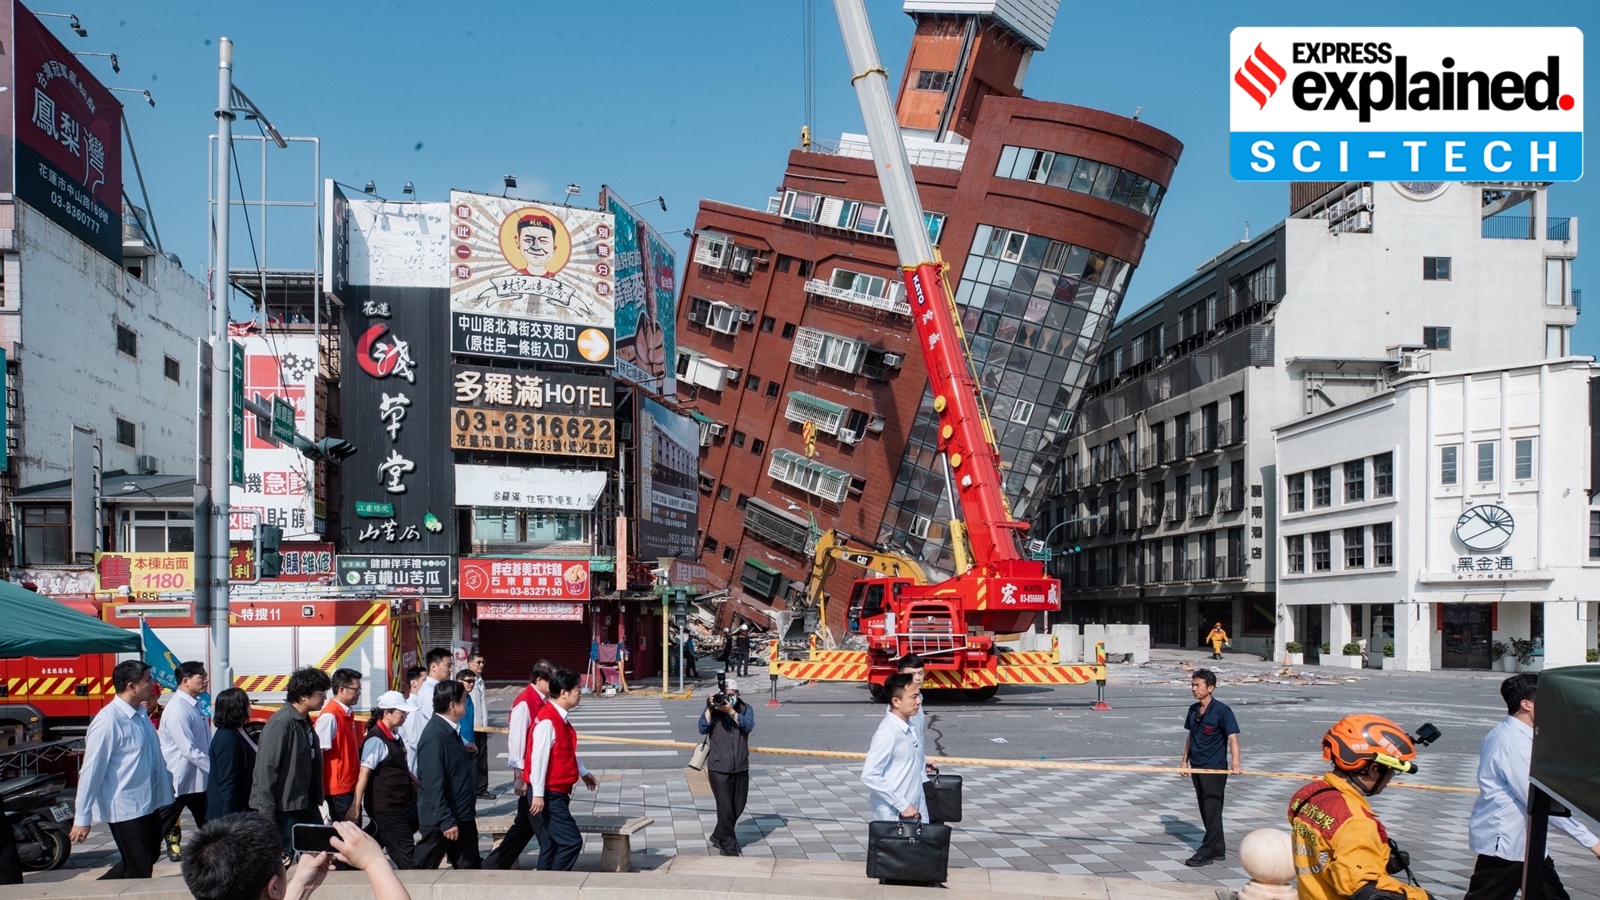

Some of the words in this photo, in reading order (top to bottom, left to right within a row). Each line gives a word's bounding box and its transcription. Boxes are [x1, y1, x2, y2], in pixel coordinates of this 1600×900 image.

[51, 191, 100, 234] 03-8360777
[913, 274, 925, 304] KATO
[458, 314, 576, 341] 中山路北濱街交叉路口
[465, 335, 569, 360] (原住民一條街入口)
[545, 383, 612, 407] HOTEL
[455, 409, 613, 440] 03-8316622
[134, 557, 189, 570] 本棟店面
[856, 555, 869, 565] CAT
[1457, 556, 1513, 572] 黑金通
[143, 573, 184, 589] 1180
[363, 570, 440, 585] 有機山苦瓜
[509, 587, 562, 596] 03-8327130
[240, 607, 281, 621] 特搜11
